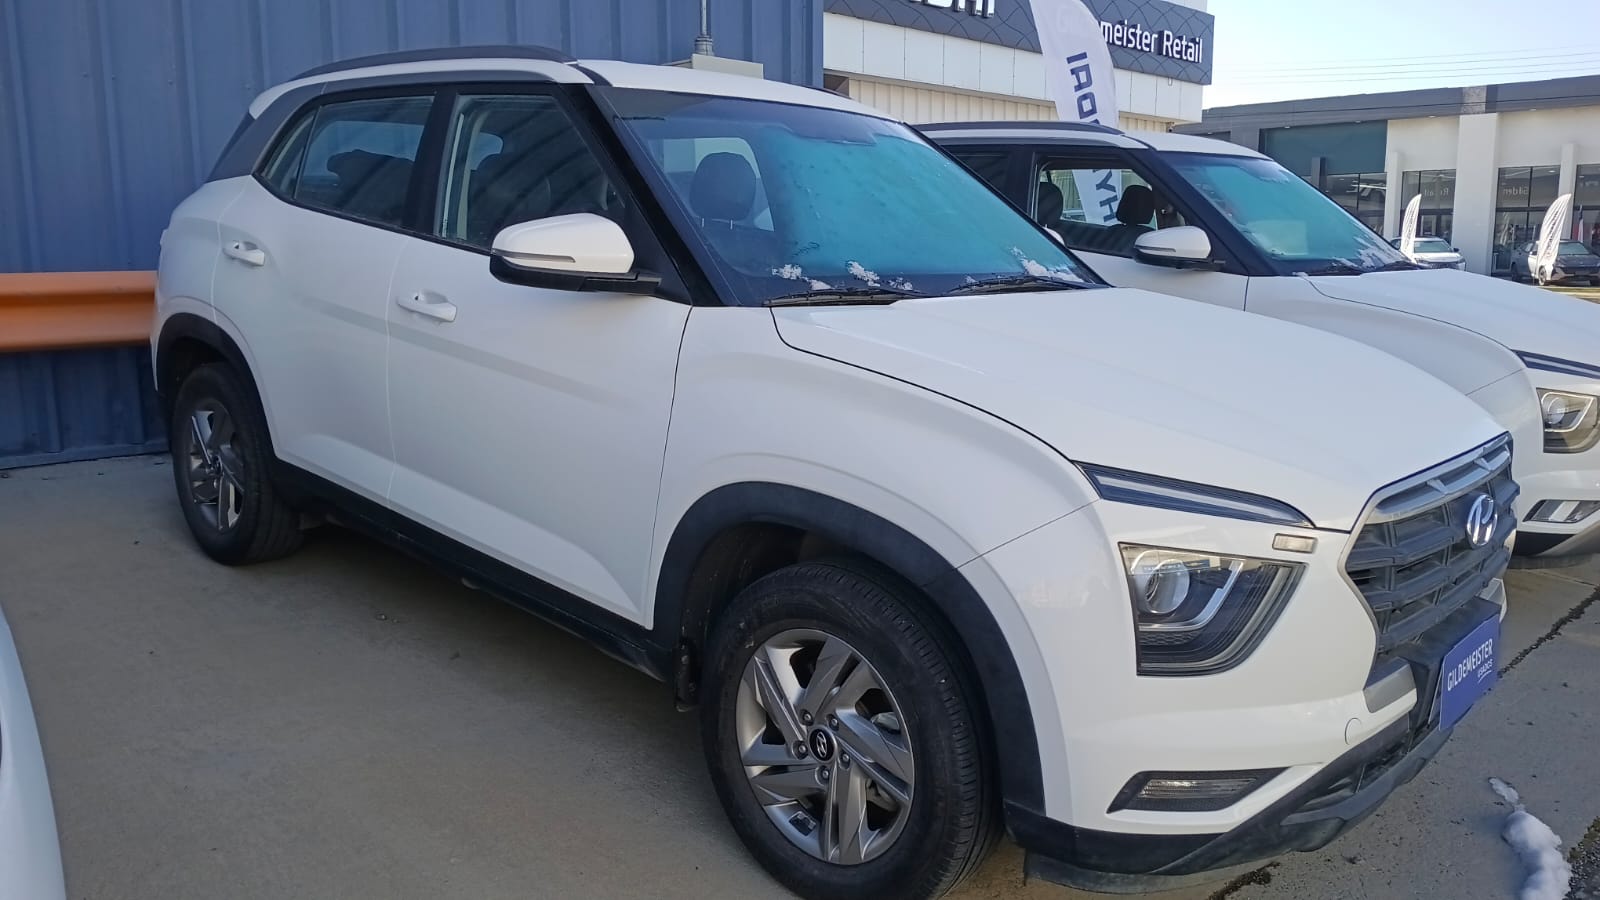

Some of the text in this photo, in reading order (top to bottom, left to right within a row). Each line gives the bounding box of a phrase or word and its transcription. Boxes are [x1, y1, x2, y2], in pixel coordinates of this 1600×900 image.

[1100, 20, 1203, 63] meister Retail
[1447, 638, 1493, 691] GILDEMEISTER
